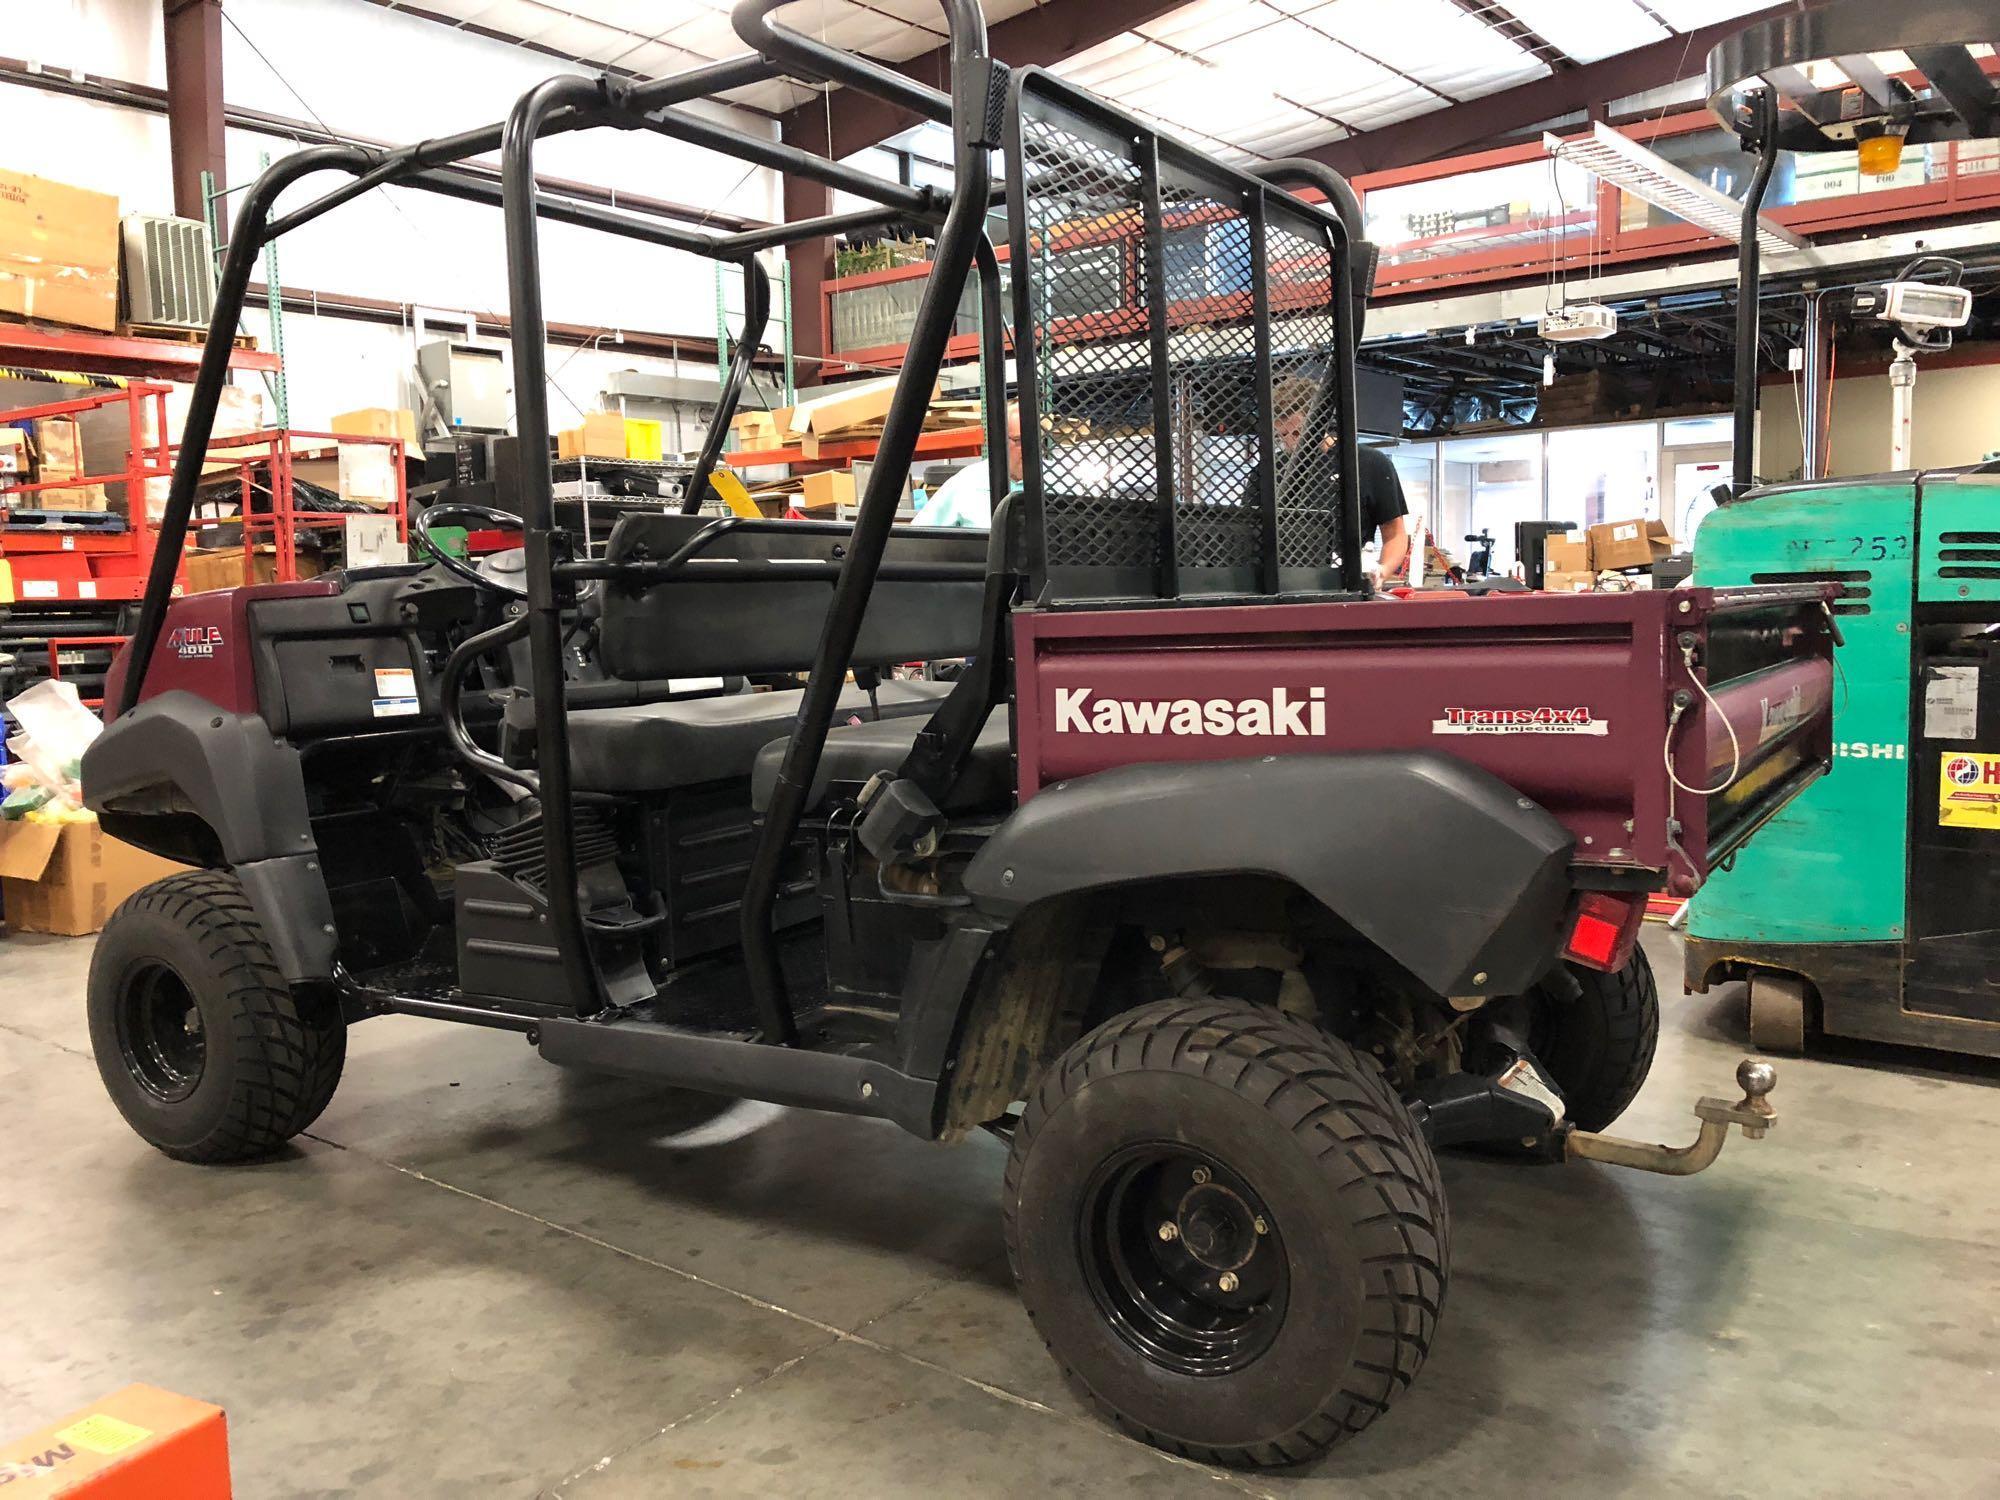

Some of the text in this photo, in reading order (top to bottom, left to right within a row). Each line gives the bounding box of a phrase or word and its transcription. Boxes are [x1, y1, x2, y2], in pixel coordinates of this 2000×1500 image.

[166, 626, 224, 648] MULE
[178, 644, 213, 655] 4010
[1055, 687, 1327, 736] Kawasaki
[1444, 706, 1593, 726] Trans4x4
